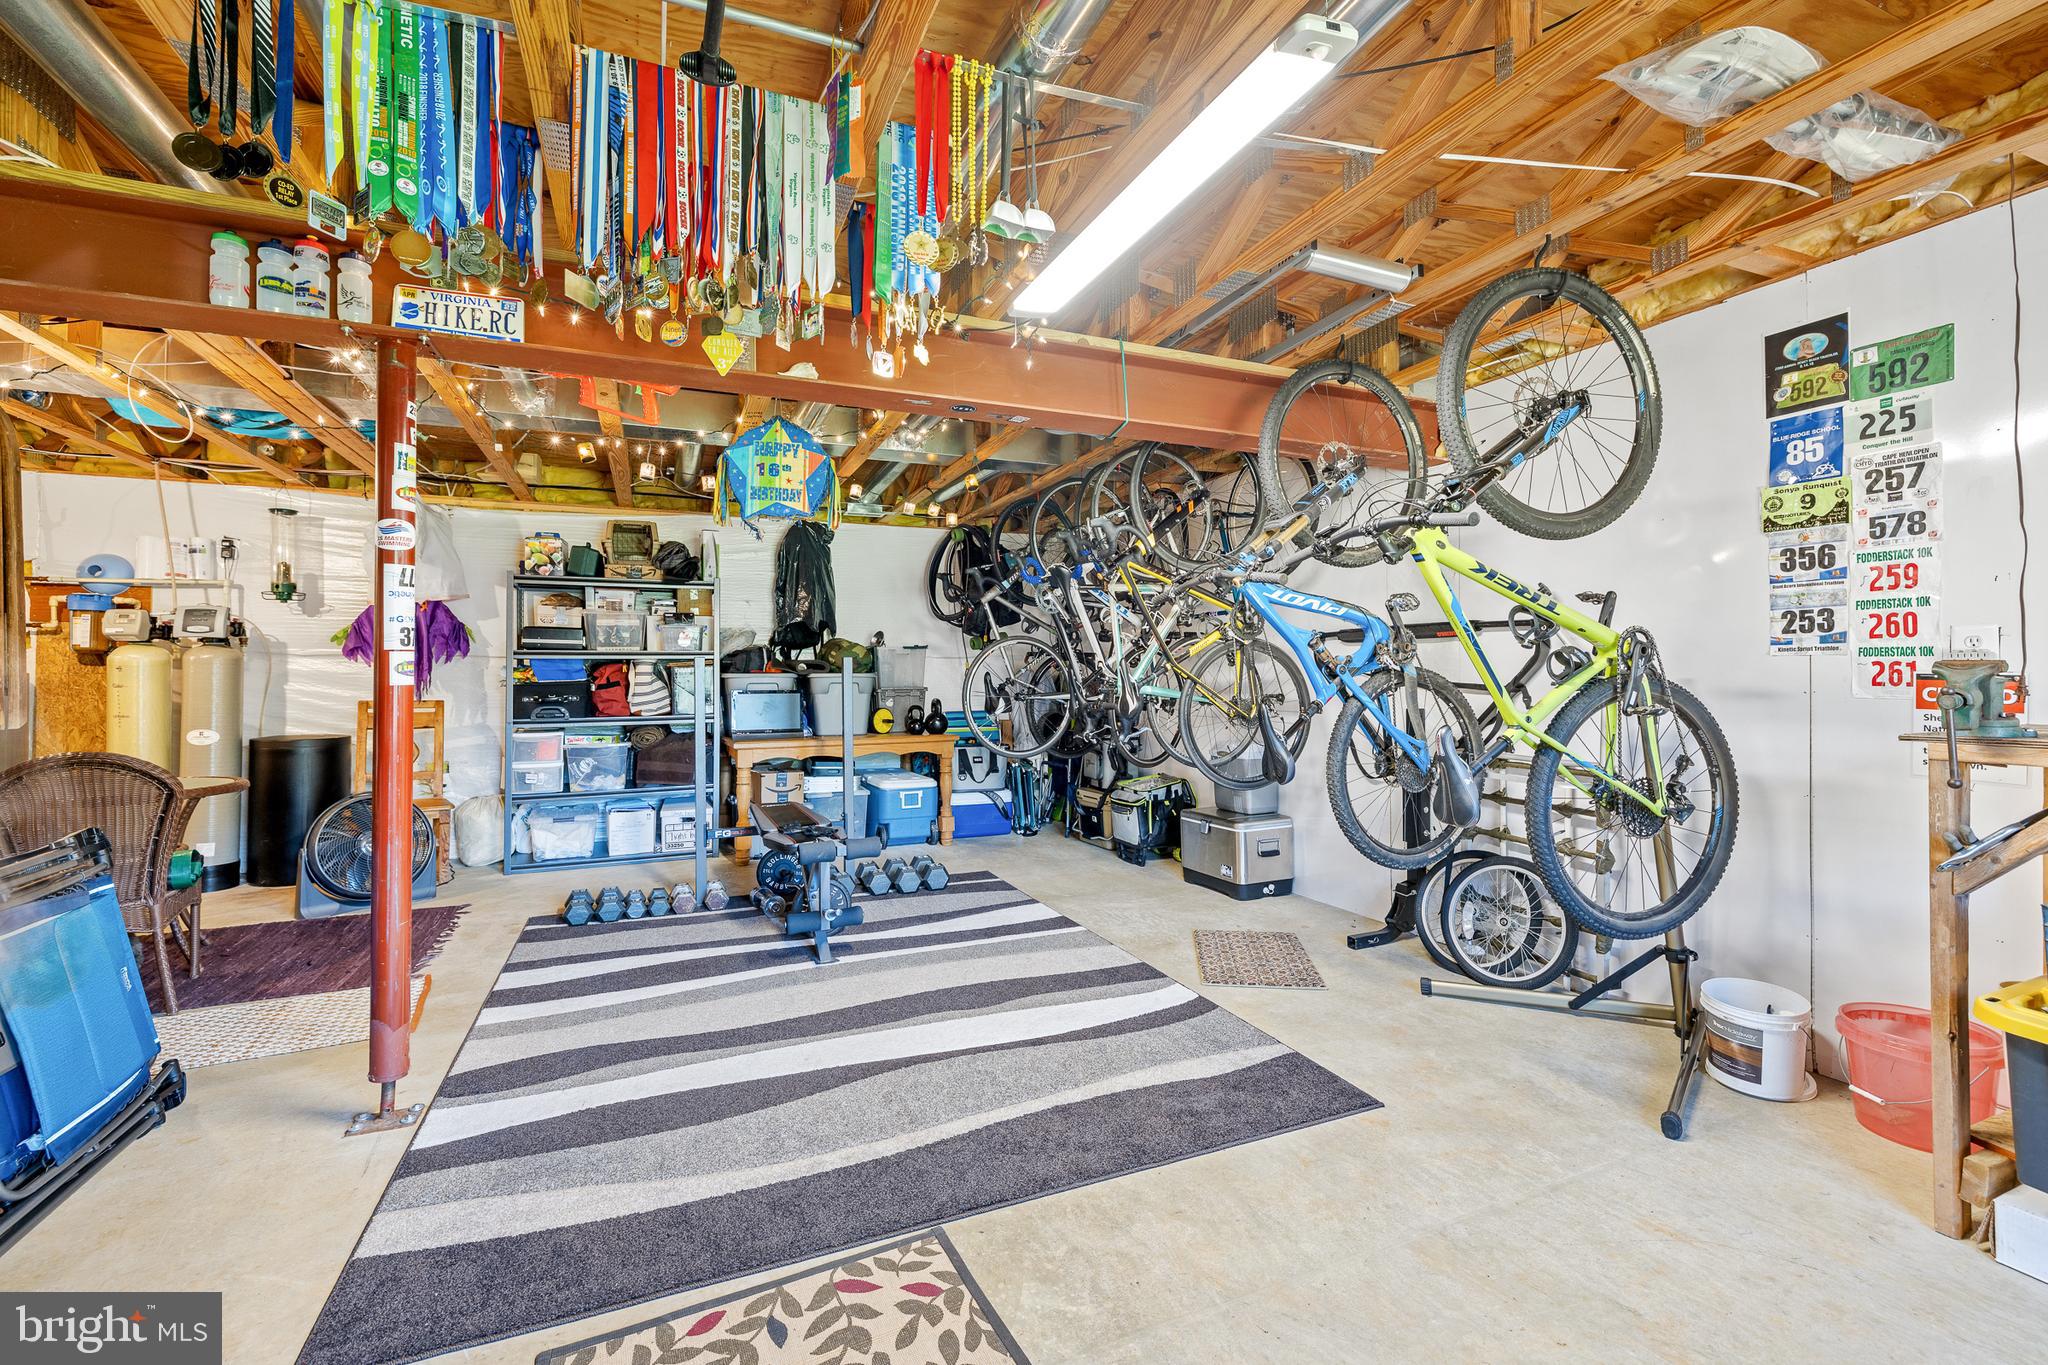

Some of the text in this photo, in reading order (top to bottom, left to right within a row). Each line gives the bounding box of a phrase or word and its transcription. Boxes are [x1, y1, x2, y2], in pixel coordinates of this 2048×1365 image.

[419, 72, 428, 121] 2018 FINISHER
[677, 79, 685, 107] SOCCER
[408, 96, 417, 120] SPRINT
[677, 119, 685, 147] SOCCER
[277, 180, 295, 191] CO-ED
[678, 160, 686, 188] SOCCER
[277, 187, 295, 198] RELAY
[680, 201, 688, 229] SOCCER
[891, 205, 906, 272] FINISHER
[430, 292, 491, 308] VIRGINIA
[1869, 352, 1930, 394] 592
[1790, 376, 1829, 402] 592
[1811, 424, 1841, 438] SCHOOL
[1859, 403, 1917, 441] 225
[754, 441, 801, 459] HAPPY
[1786, 435, 1825, 466] 85
[1862, 440, 1889, 450] Conquer
[1902, 435, 1914, 443] Hill
[1882, 447, 1930, 461] CAPE HENLOPEN
[756, 462, 792, 477] 16th
[1864, 461, 1926, 495] 257
[749, 485, 803, 502] BIRTHDAY
[1773, 480, 1843, 495] Sonya Runquist
[1800, 493, 1816, 510] 9
[1869, 510, 1927, 540] 578
[1779, 543, 1837, 573] 356
[1856, 547, 1933, 564] FODDERSTACK 10K
[1468, 560, 1561, 617] TREK
[1869, 562, 1920, 592] 259
[1263, 591, 1350, 617] PIVOT
[1855, 596, 1931, 611] FODDERSTACK 10K
[1781, 607, 1836, 635] 253
[1868, 611, 1919, 640] 260
[1858, 645, 1935, 657] FODDERSTACK 10K
[1871, 660, 1917, 688] 261
